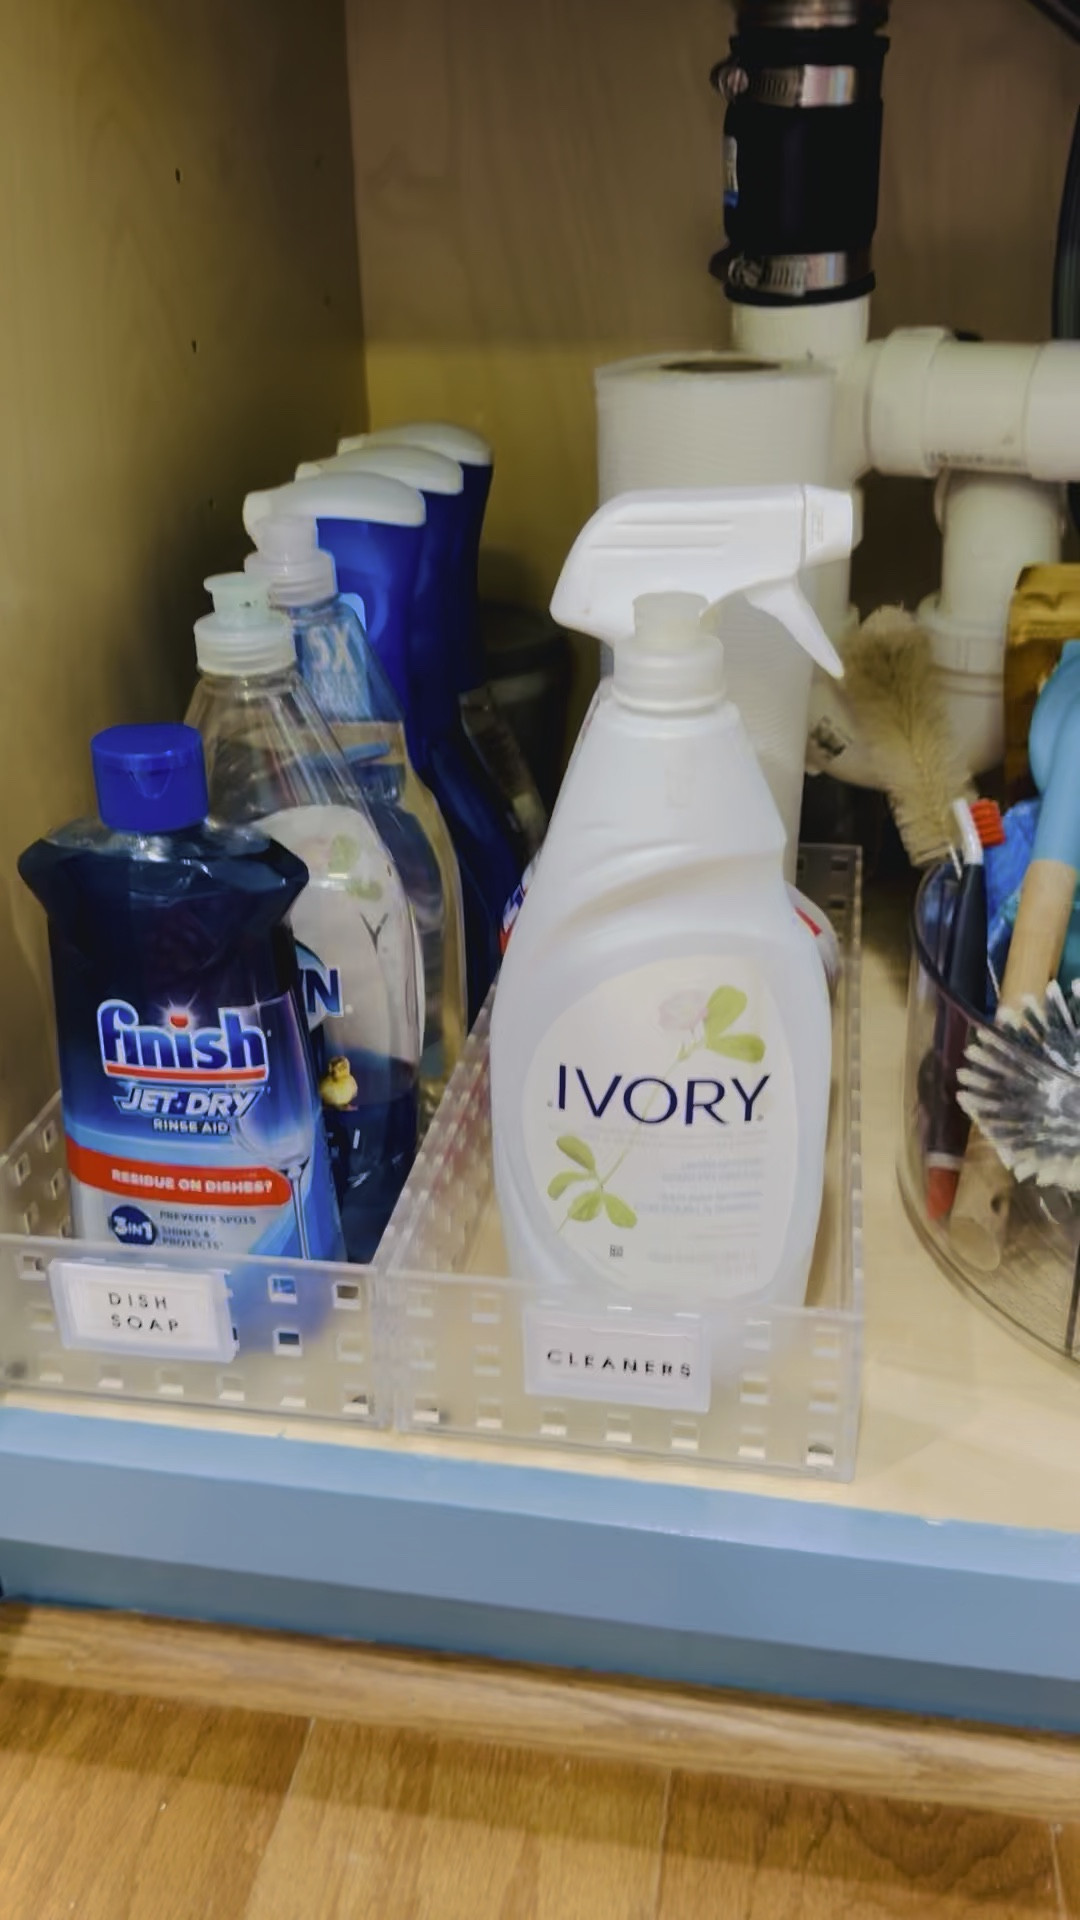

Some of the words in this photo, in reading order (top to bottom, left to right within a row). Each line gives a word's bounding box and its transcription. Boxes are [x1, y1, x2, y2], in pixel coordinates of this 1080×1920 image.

[97, 999, 269, 1072] finish
[557, 1062, 770, 1126] IVORY
[153, 1117, 199, 1133] RINSE
[202, 1121, 229, 1135] AID
[111, 1168, 175, 1191] RESIDUE
[178, 1177, 202, 1192] ON
[205, 1179, 273, 1195] DISHES?
[219, 1214, 257, 1225] SPOTS
[107, 1291, 167, 1310] DISH
[110, 1313, 179, 1332] SOAP
[547, 1349, 691, 1379] CLEANERS
